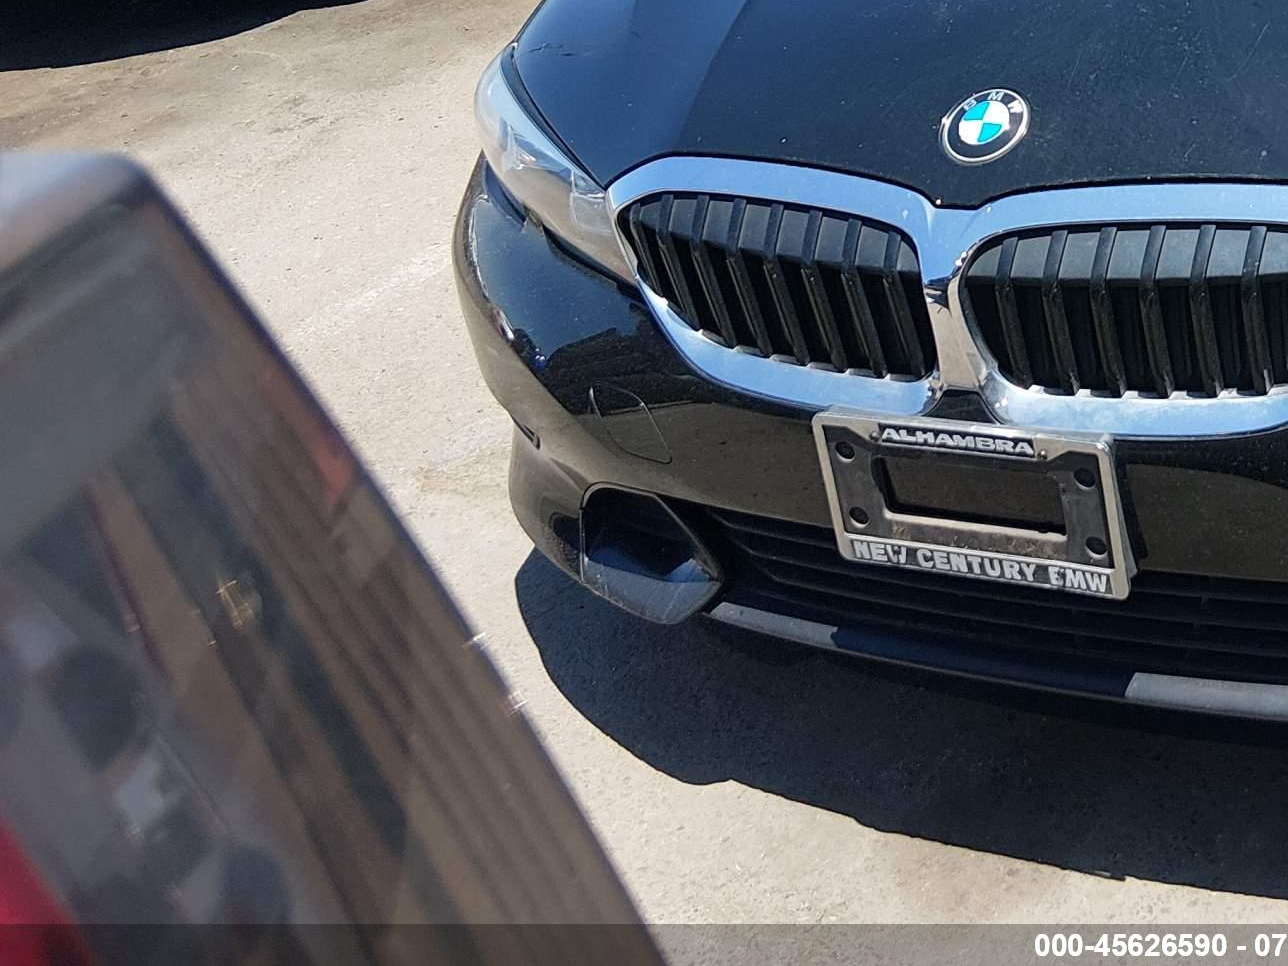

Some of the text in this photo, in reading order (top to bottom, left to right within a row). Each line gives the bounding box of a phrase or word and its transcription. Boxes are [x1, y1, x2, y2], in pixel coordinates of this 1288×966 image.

[963, 91, 1024, 114] BMW
[882, 428, 1034, 456] ALHAMBRA
[853, 540, 907, 564] NEW
[917, 549, 1038, 583] CENTURY
